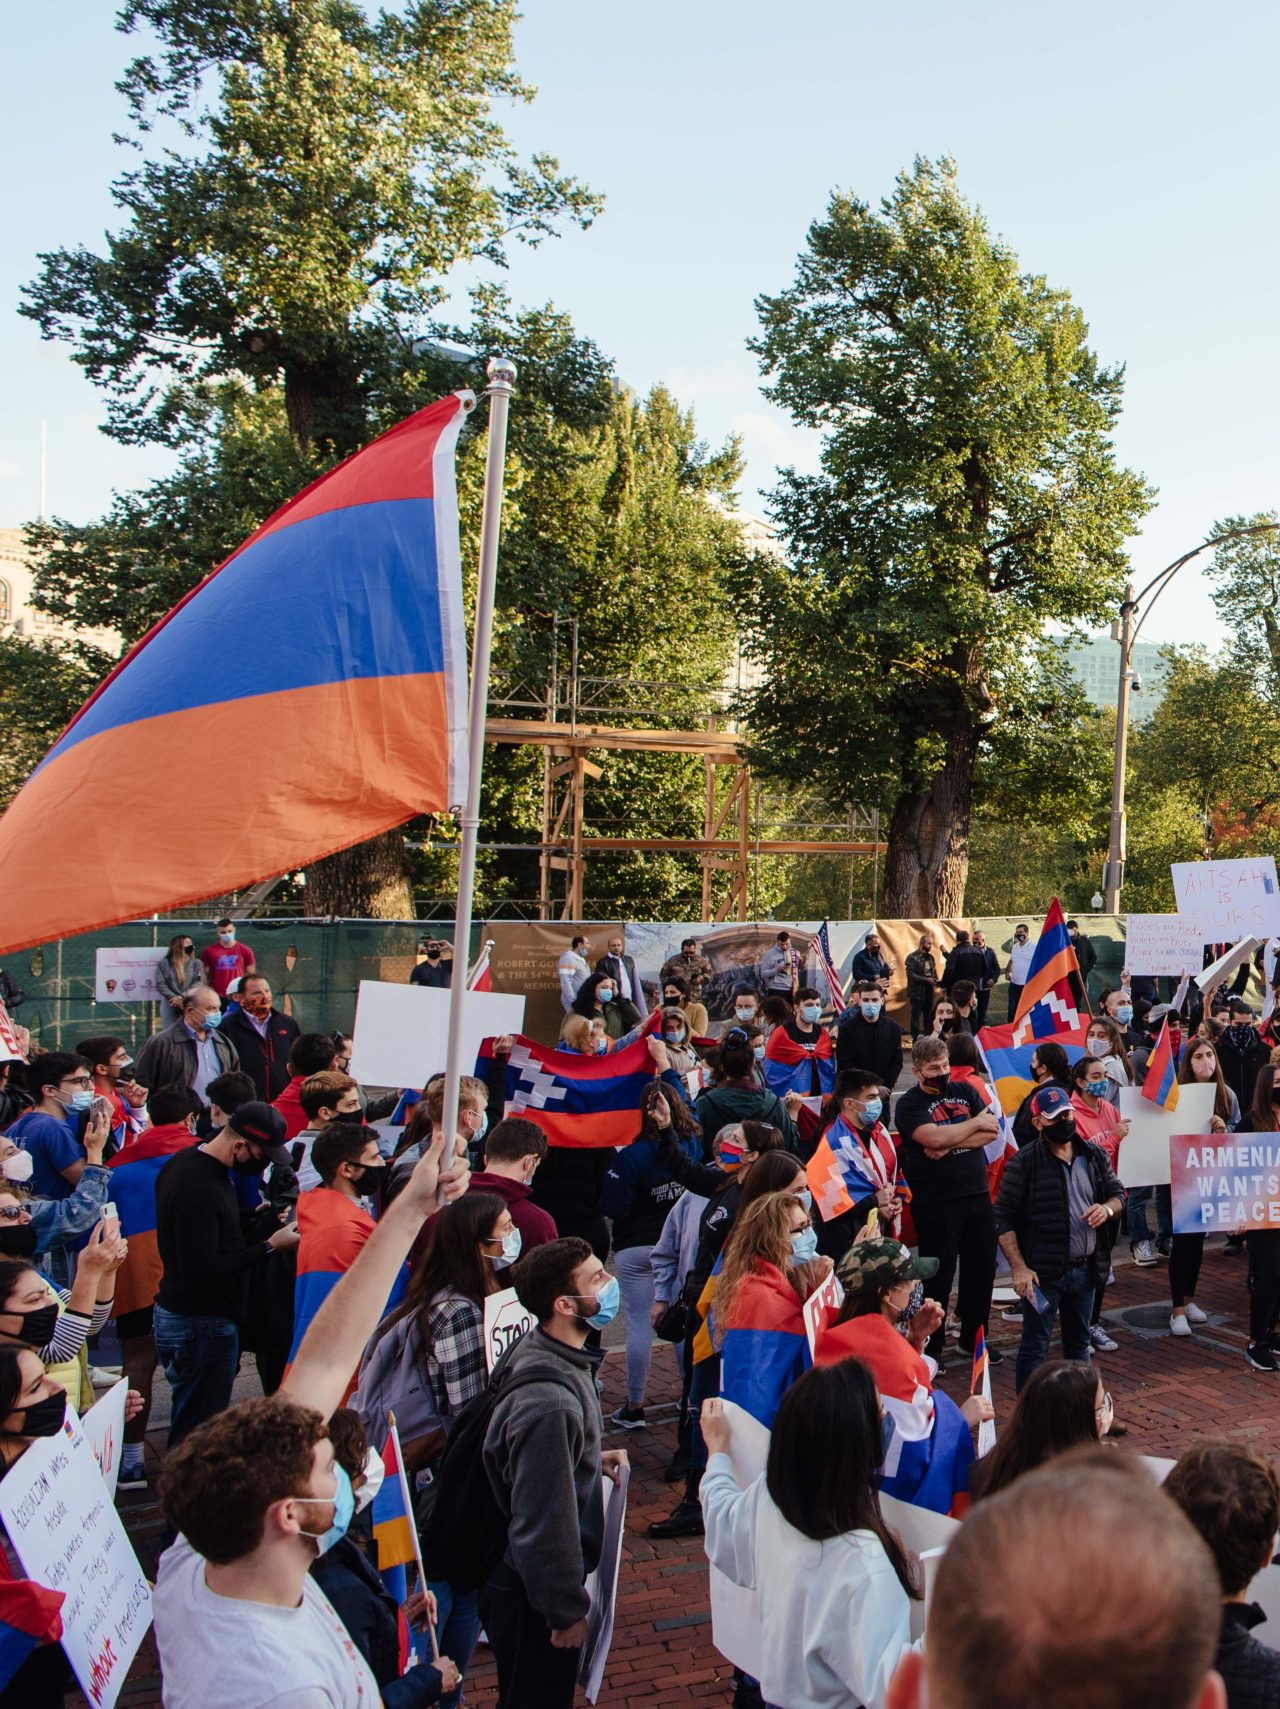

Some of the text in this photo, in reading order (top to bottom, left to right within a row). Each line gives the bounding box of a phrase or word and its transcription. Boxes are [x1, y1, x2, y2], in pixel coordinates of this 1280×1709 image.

[497, 960, 536, 968] ROBERT
[509, 971, 529, 979] THE
[523, 982, 561, 990] MEMOR
[1197, 1175, 1279, 1197] WANTS
[1200, 1201, 1280, 1224] PEACE
